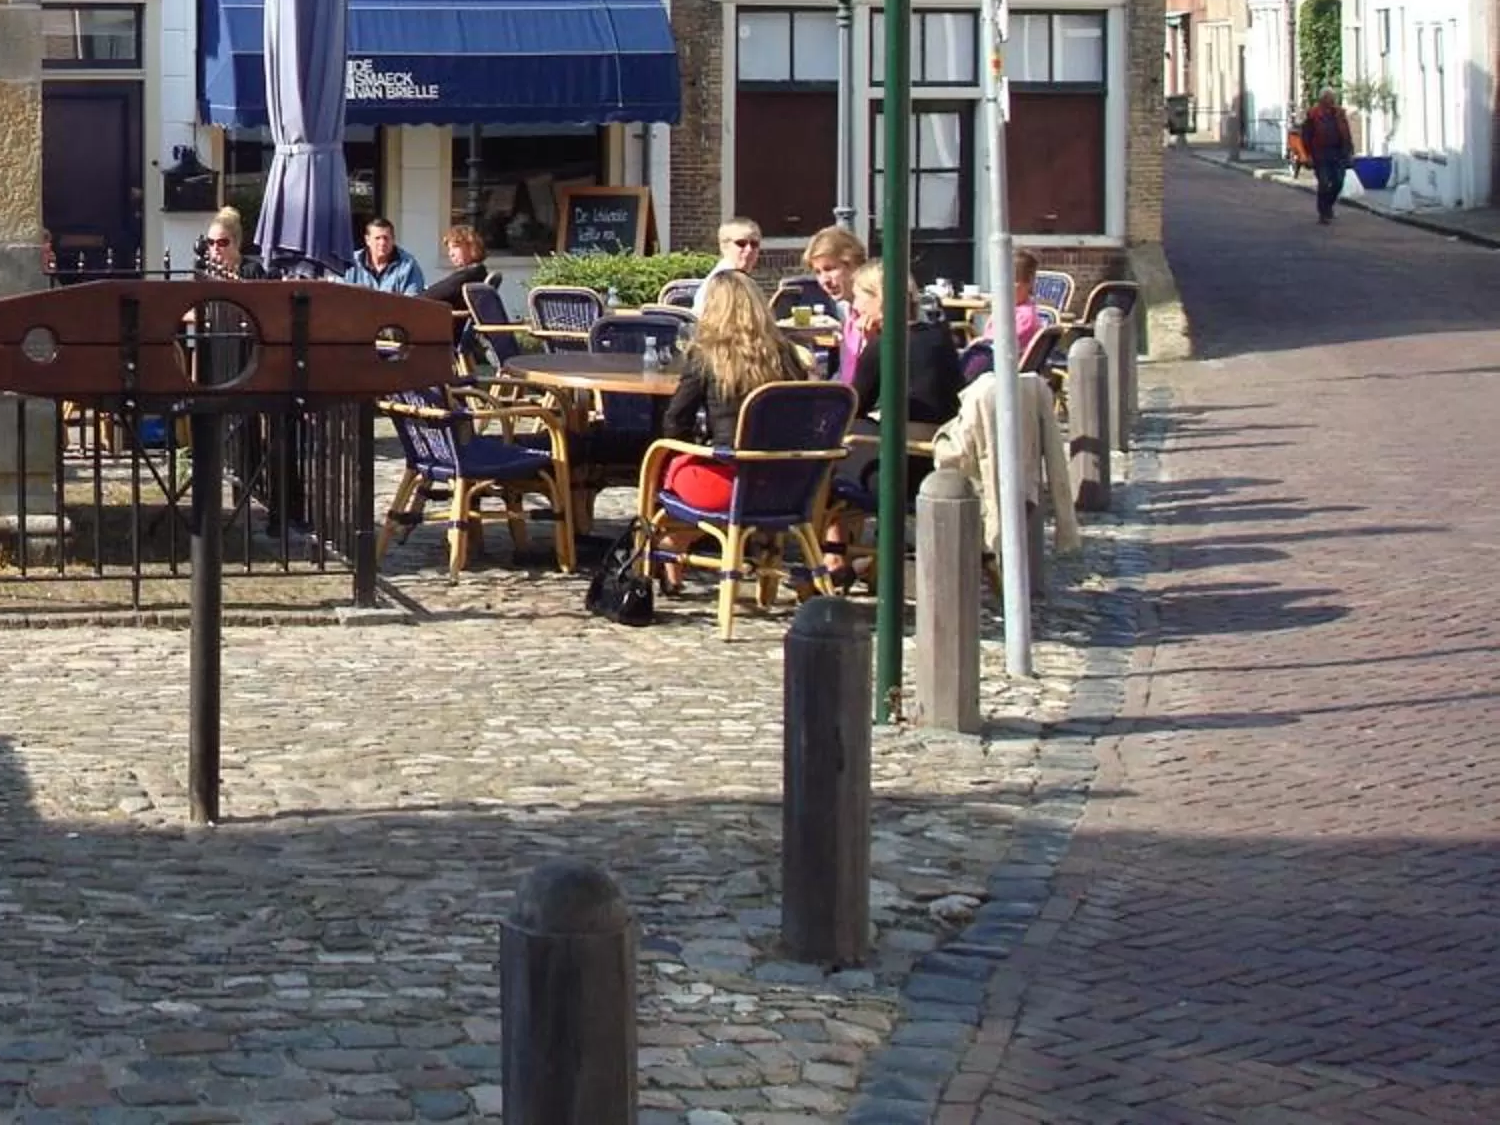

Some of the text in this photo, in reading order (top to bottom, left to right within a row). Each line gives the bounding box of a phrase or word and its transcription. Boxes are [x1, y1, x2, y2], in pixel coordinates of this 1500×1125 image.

[354, 59, 373, 73] DE
[355, 72, 413, 86] SMAECK
[355, 84, 440, 99] VAN BRIELLE
